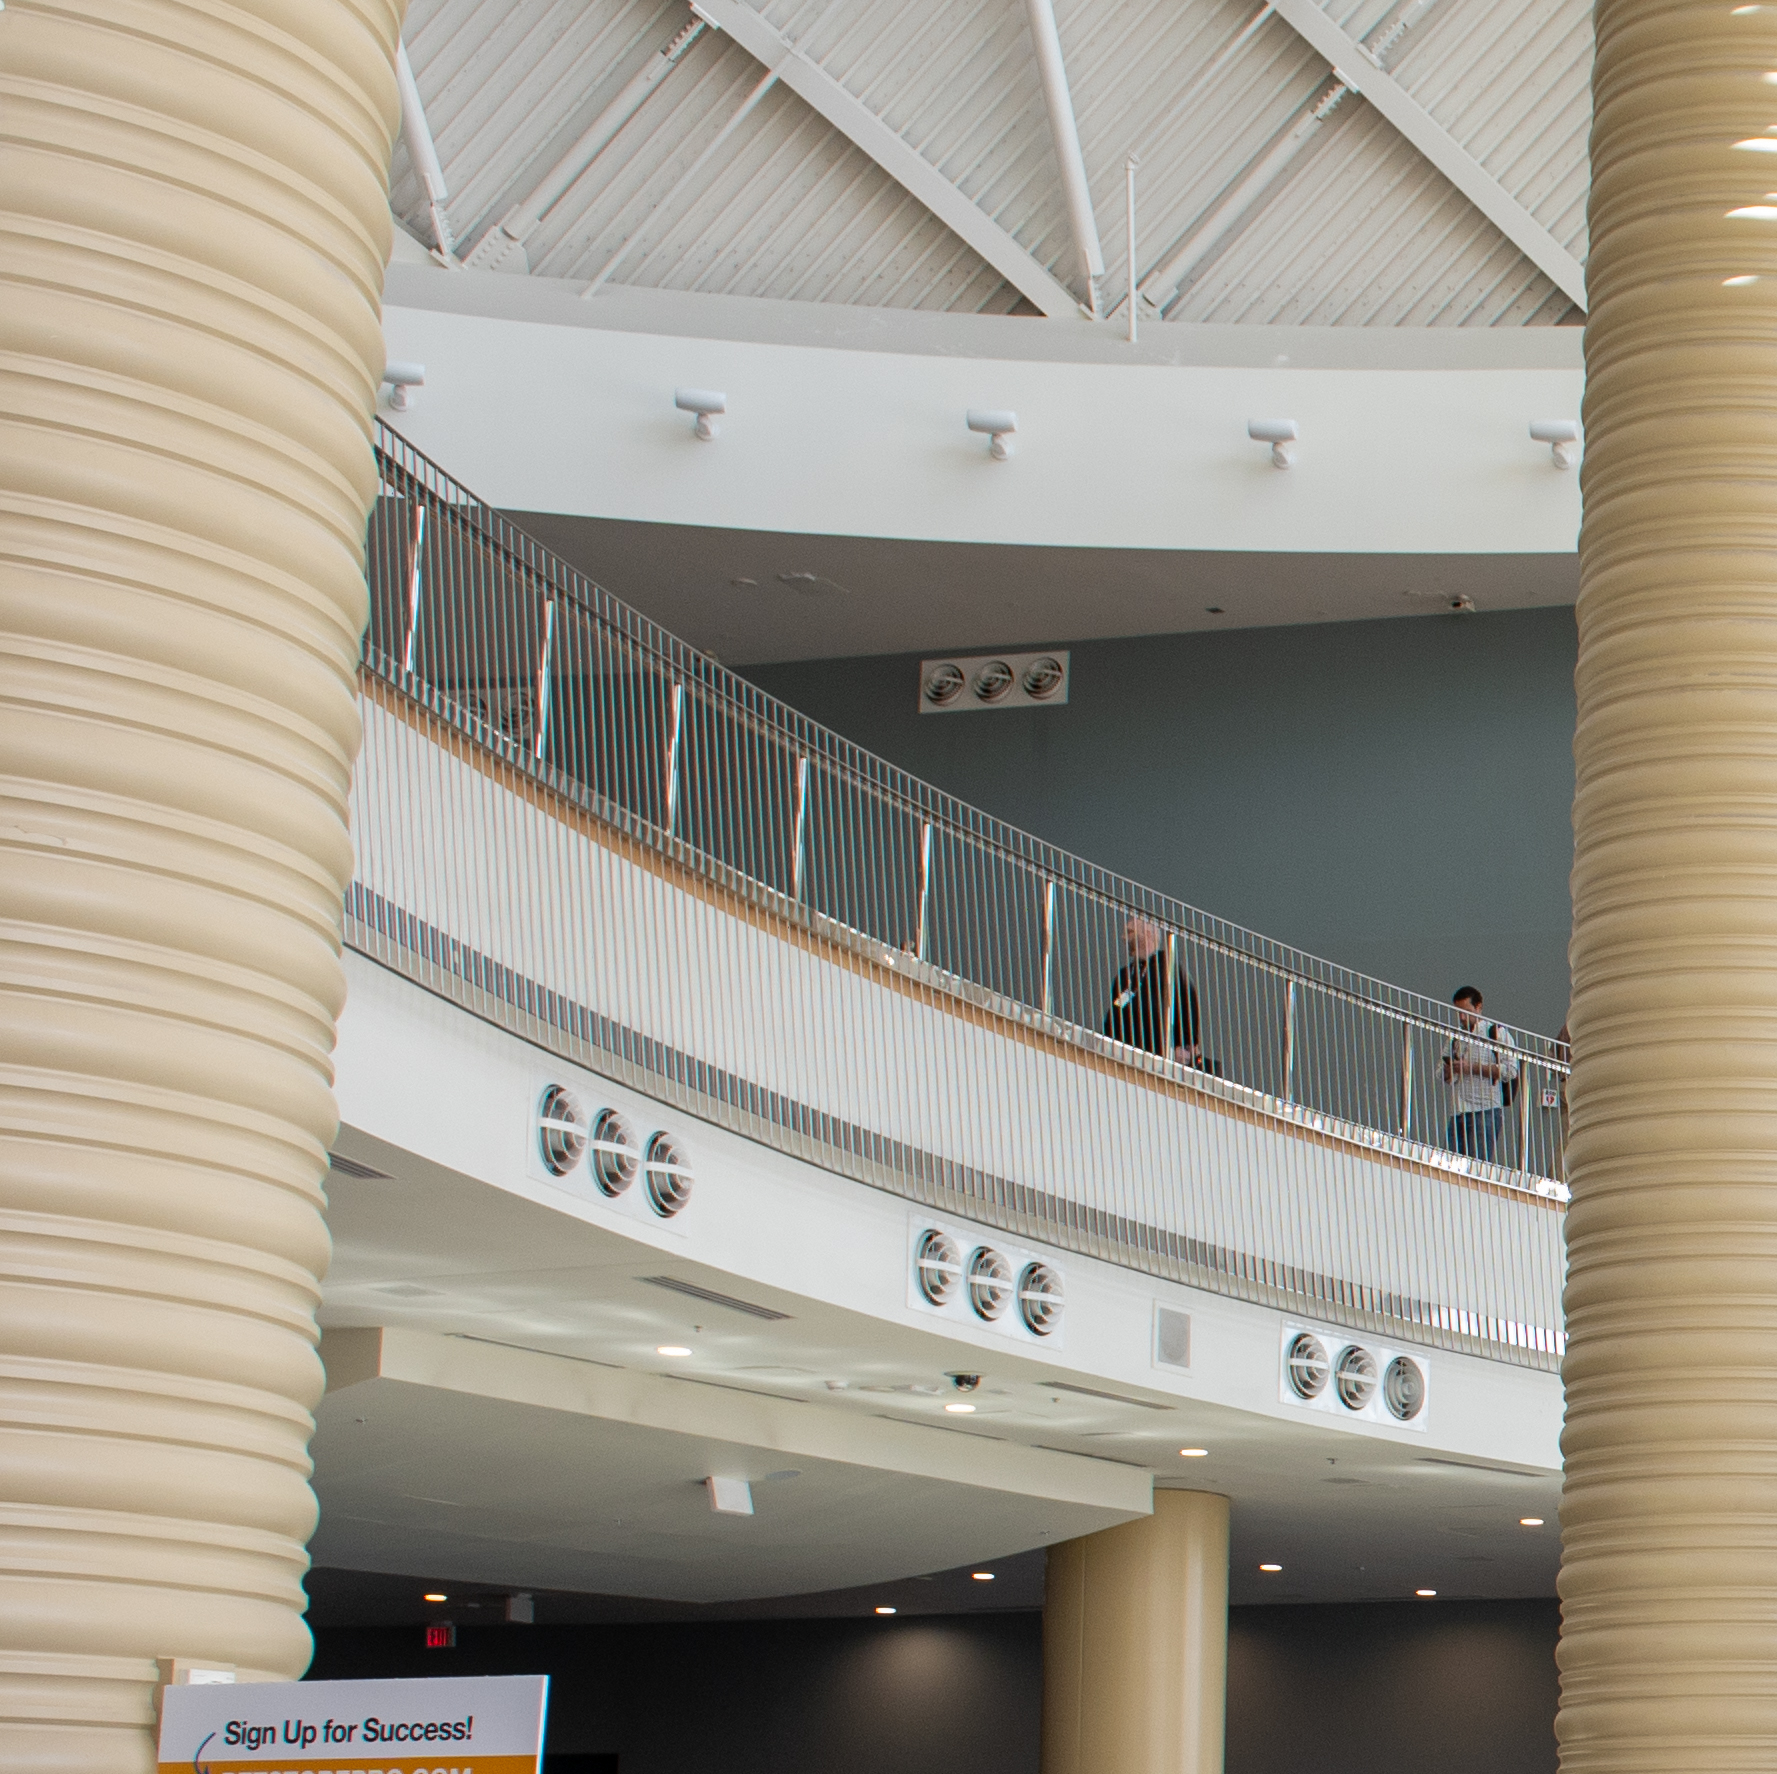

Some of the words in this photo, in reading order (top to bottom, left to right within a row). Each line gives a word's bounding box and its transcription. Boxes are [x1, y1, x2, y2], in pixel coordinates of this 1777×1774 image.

[224, 1720, 277, 1750] Sign
[283, 1719, 317, 1749] Up
[323, 1719, 357, 1743] for
[362, 1715, 474, 1743] Success!
